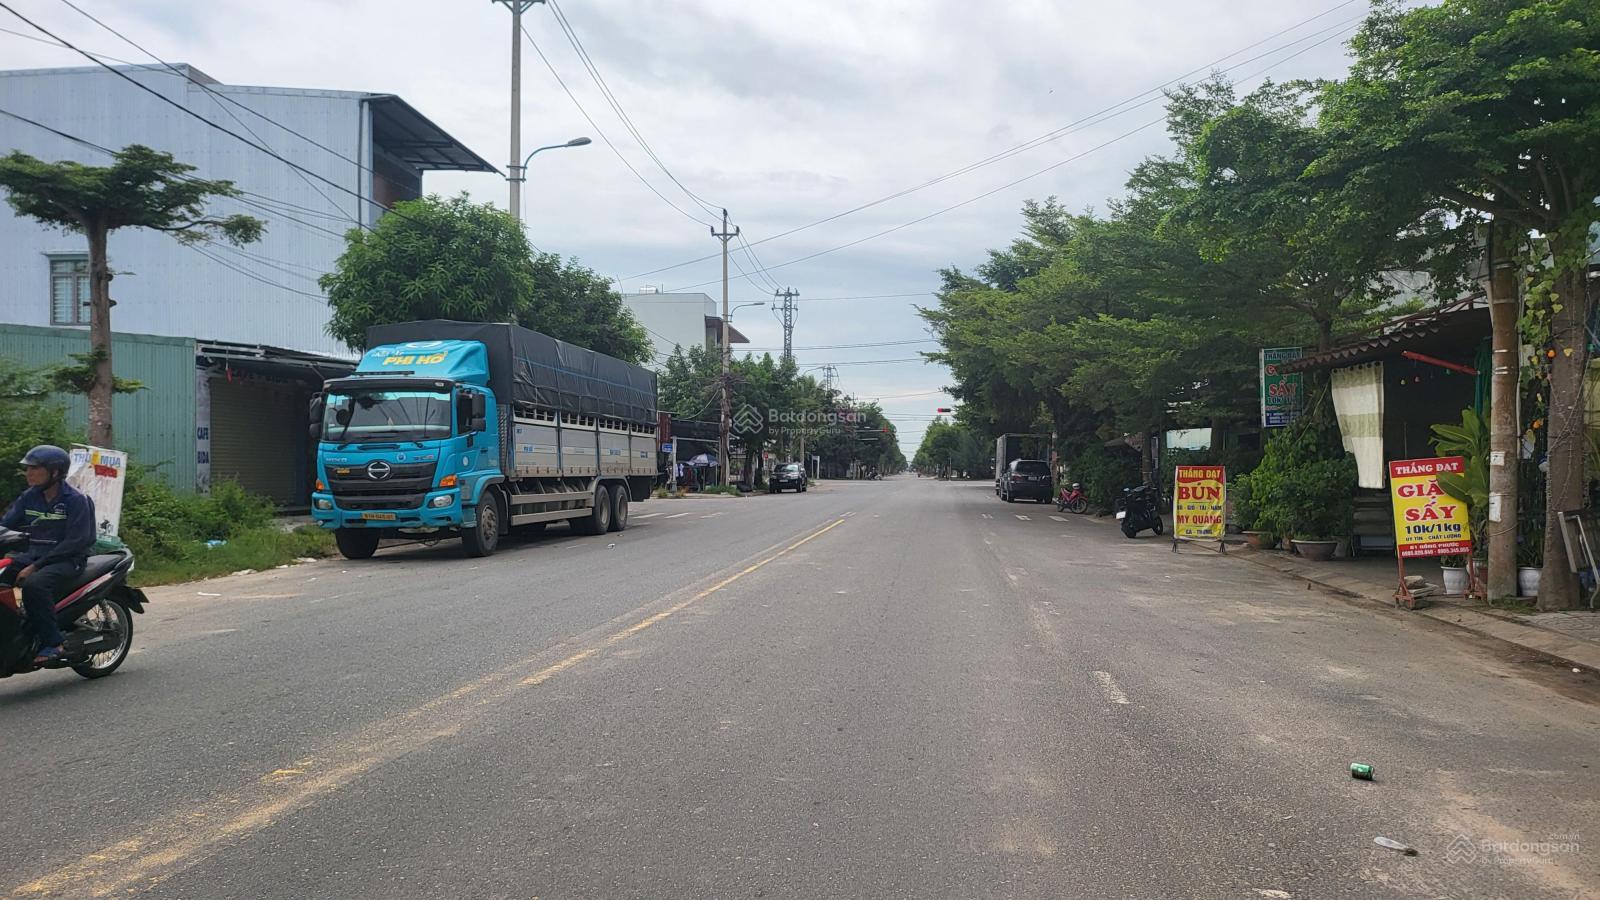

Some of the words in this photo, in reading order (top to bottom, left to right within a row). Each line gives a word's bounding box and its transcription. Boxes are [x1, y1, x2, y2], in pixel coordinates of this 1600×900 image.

[383, 355, 412, 365] PHI
[197, 426, 209, 440] CAFE
[1395, 462, 1433, 474] THẮNG
[1178, 482, 1221, 500] BÚN
[1397, 480, 1445, 498] GIẶ
[1405, 501, 1457, 521] SẤY
[1405, 523, 1461, 534] 10k/1kg
